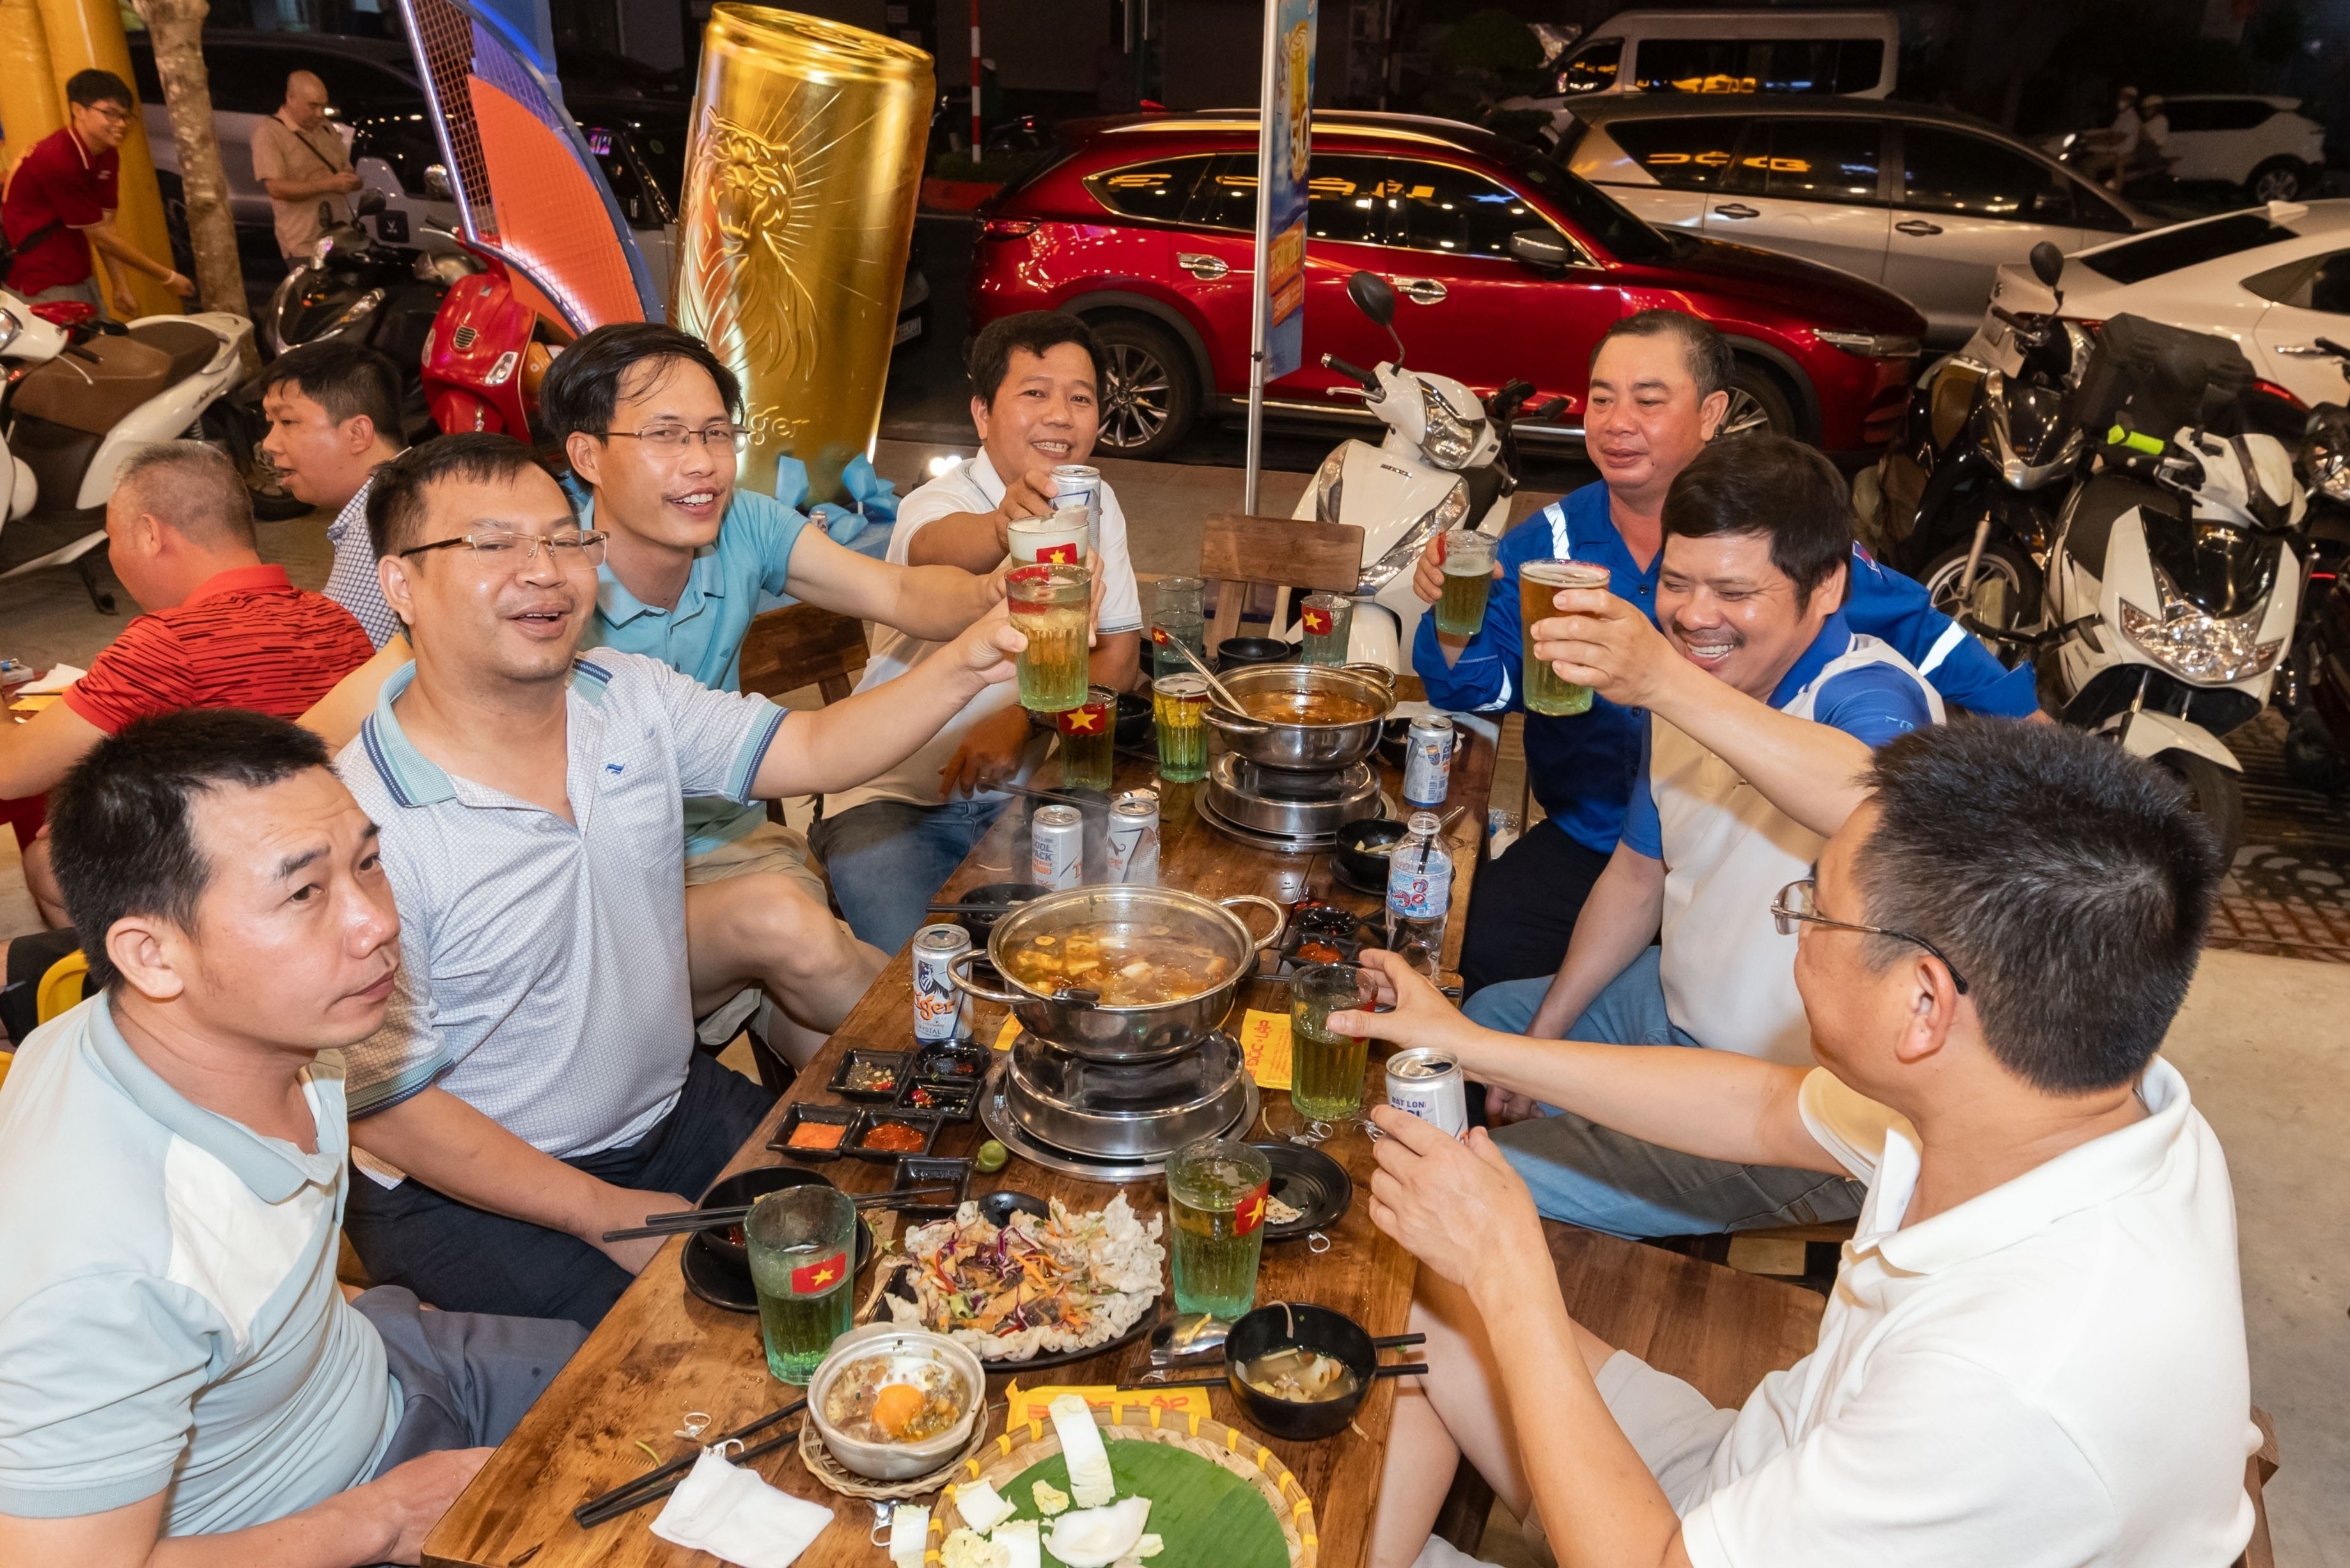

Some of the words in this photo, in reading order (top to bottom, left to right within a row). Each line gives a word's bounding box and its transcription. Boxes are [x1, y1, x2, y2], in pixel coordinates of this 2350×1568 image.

[745, 402, 810, 446] ger
[1033, 848, 1053, 861] ACK
[914, 991, 957, 1021] iger
